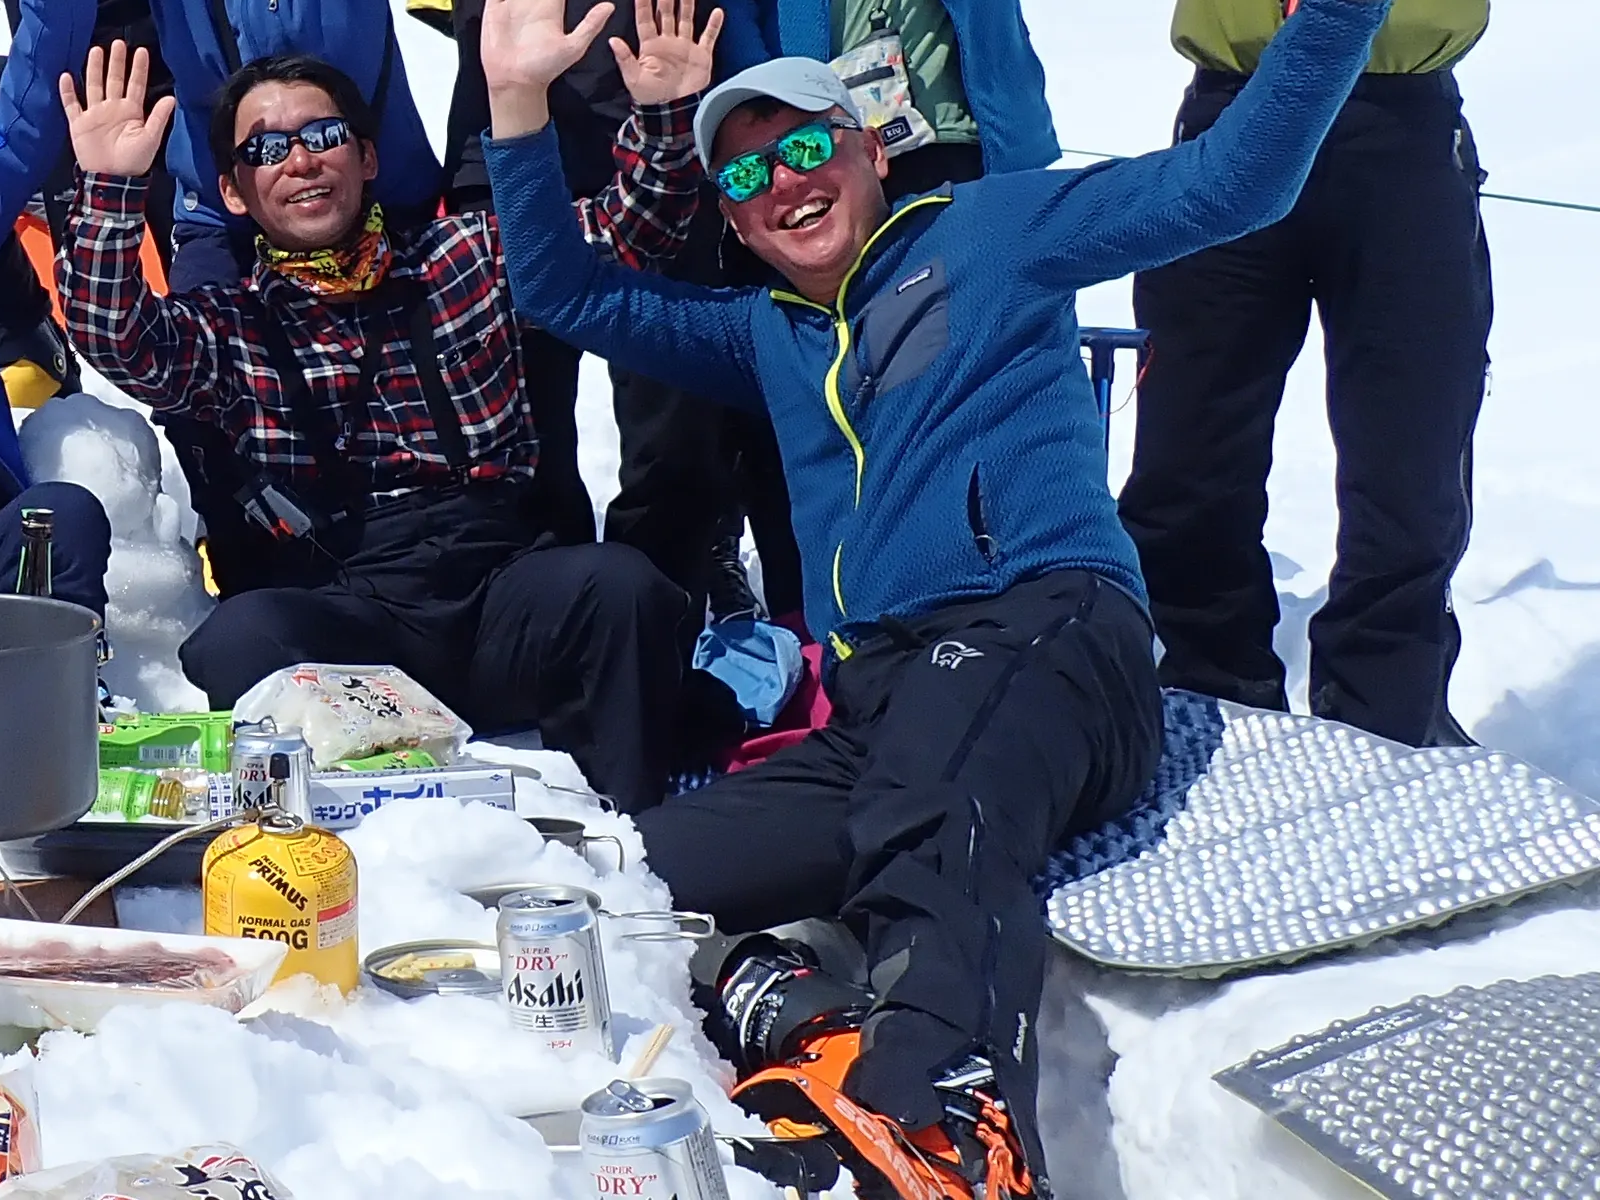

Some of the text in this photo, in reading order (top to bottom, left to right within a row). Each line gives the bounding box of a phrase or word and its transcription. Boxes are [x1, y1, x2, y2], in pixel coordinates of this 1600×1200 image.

[248, 858, 309, 912] PRIMUS
[237, 915, 311, 928] NORMAL GAS
[521, 947, 550, 955] SUPER
[507, 968, 585, 1008] Asahi
[535, 1014, 555, 1029] 生
[600, 1165, 633, 1175] SUPER
